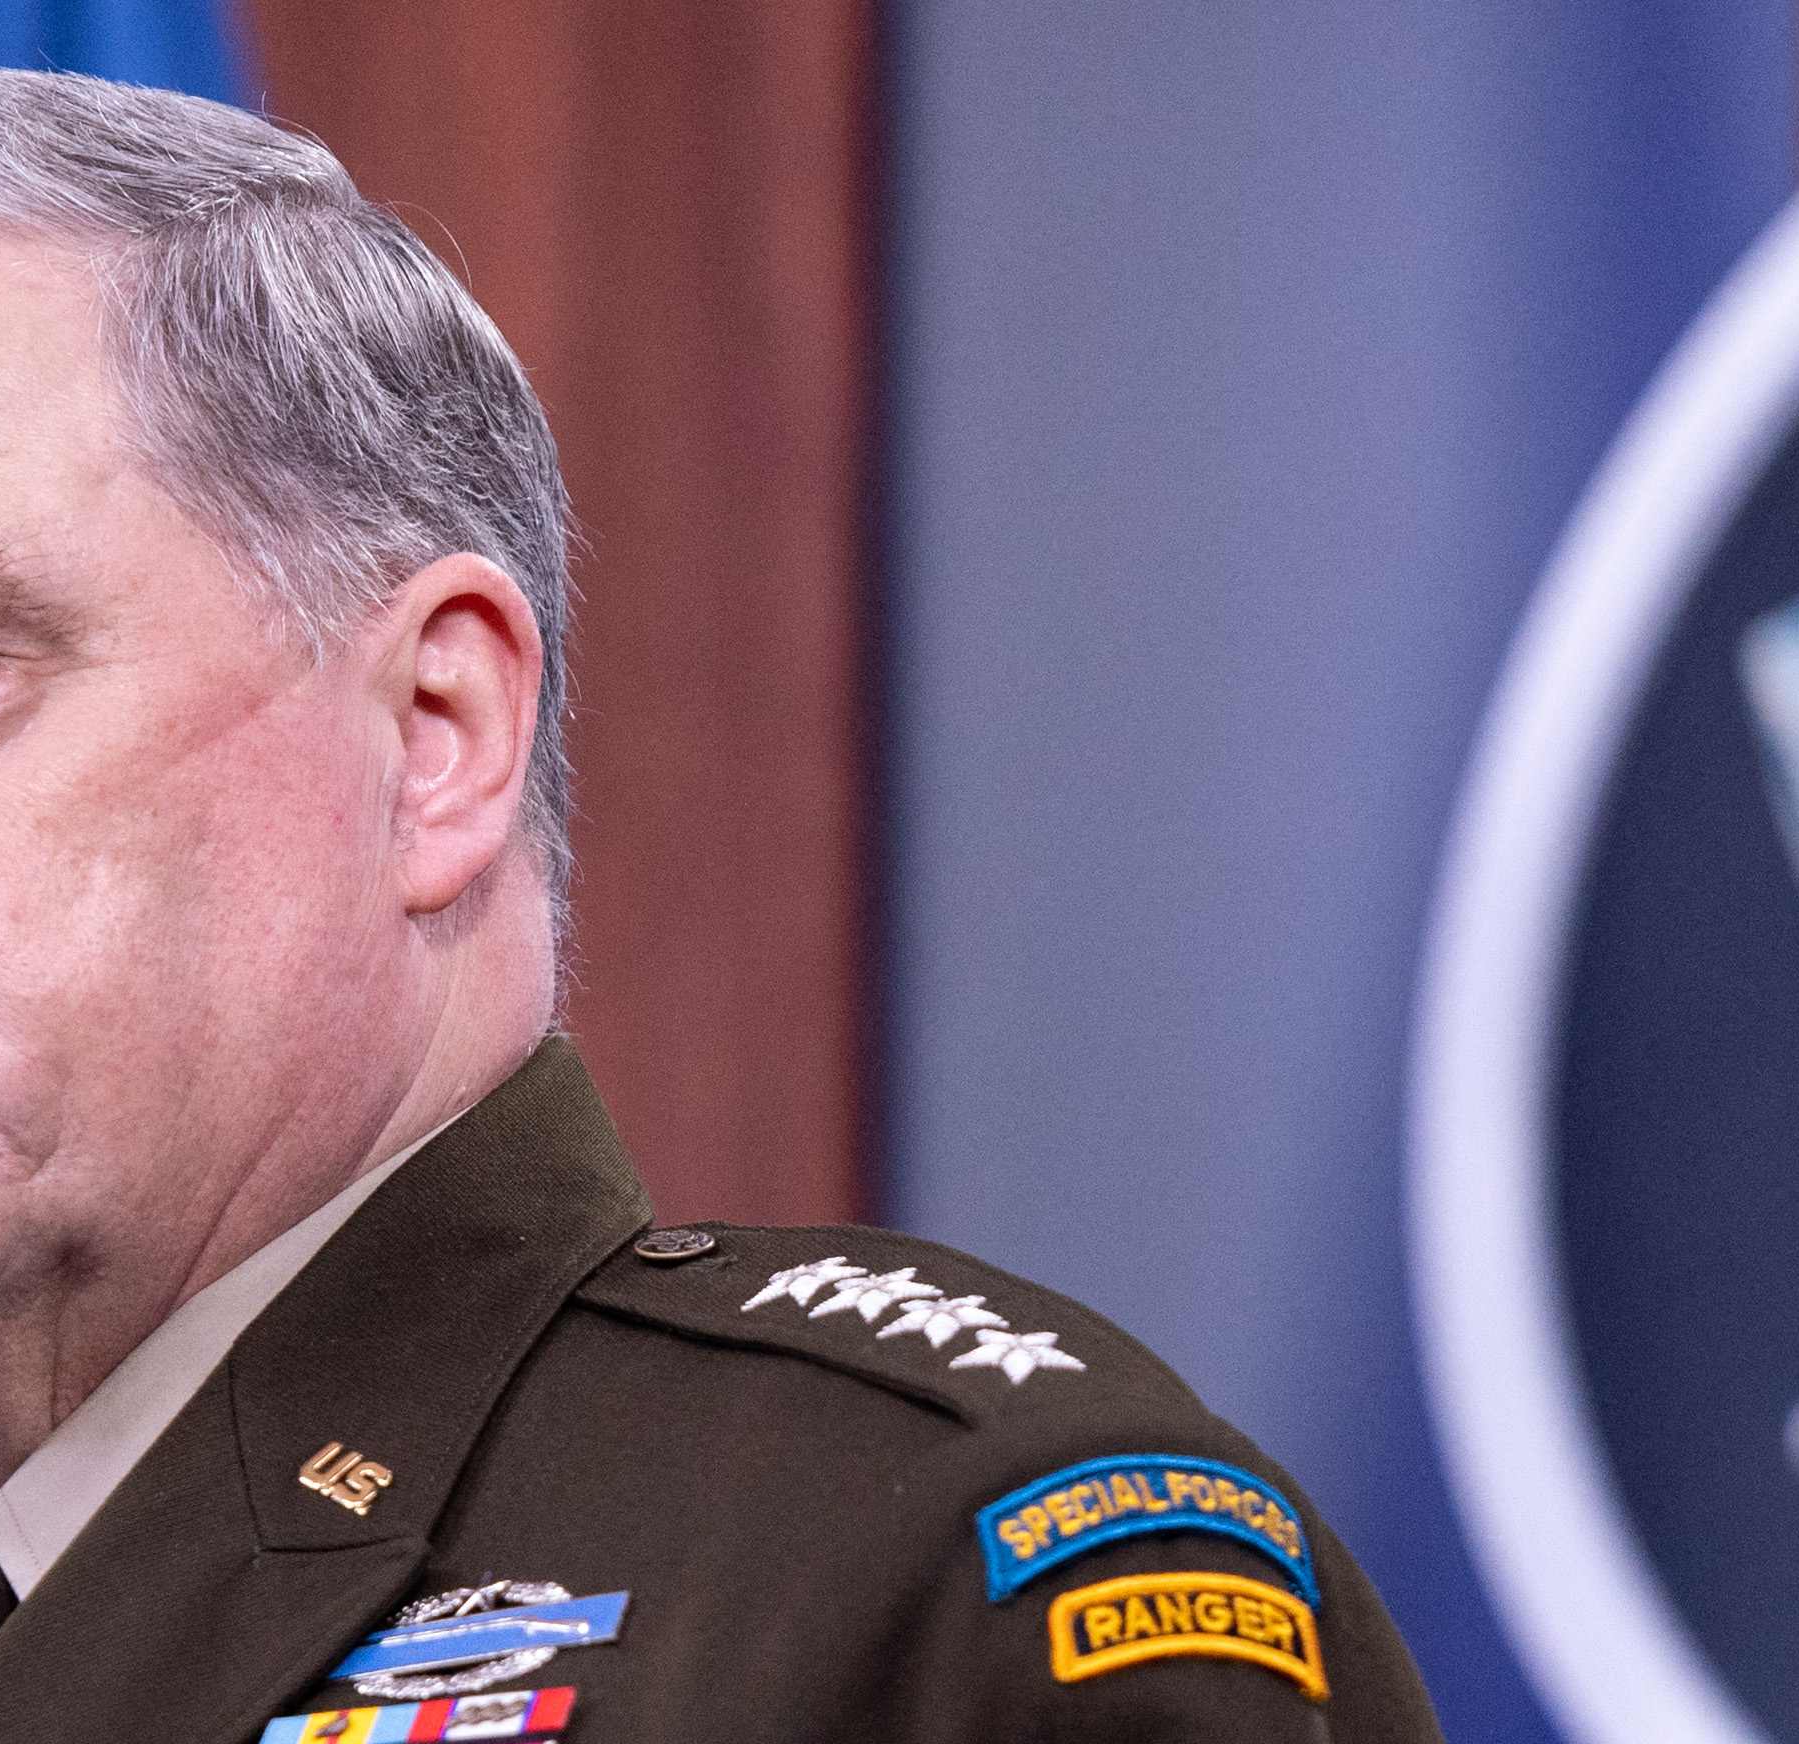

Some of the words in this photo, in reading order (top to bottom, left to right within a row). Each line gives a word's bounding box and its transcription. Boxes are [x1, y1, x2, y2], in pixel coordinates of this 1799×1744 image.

[298, 1440, 394, 1516] US
[997, 1472, 1170, 1560] SPECIAL
[1164, 1470, 1302, 1558] FORCES
[1083, 1592, 1295, 1651] RANGER
